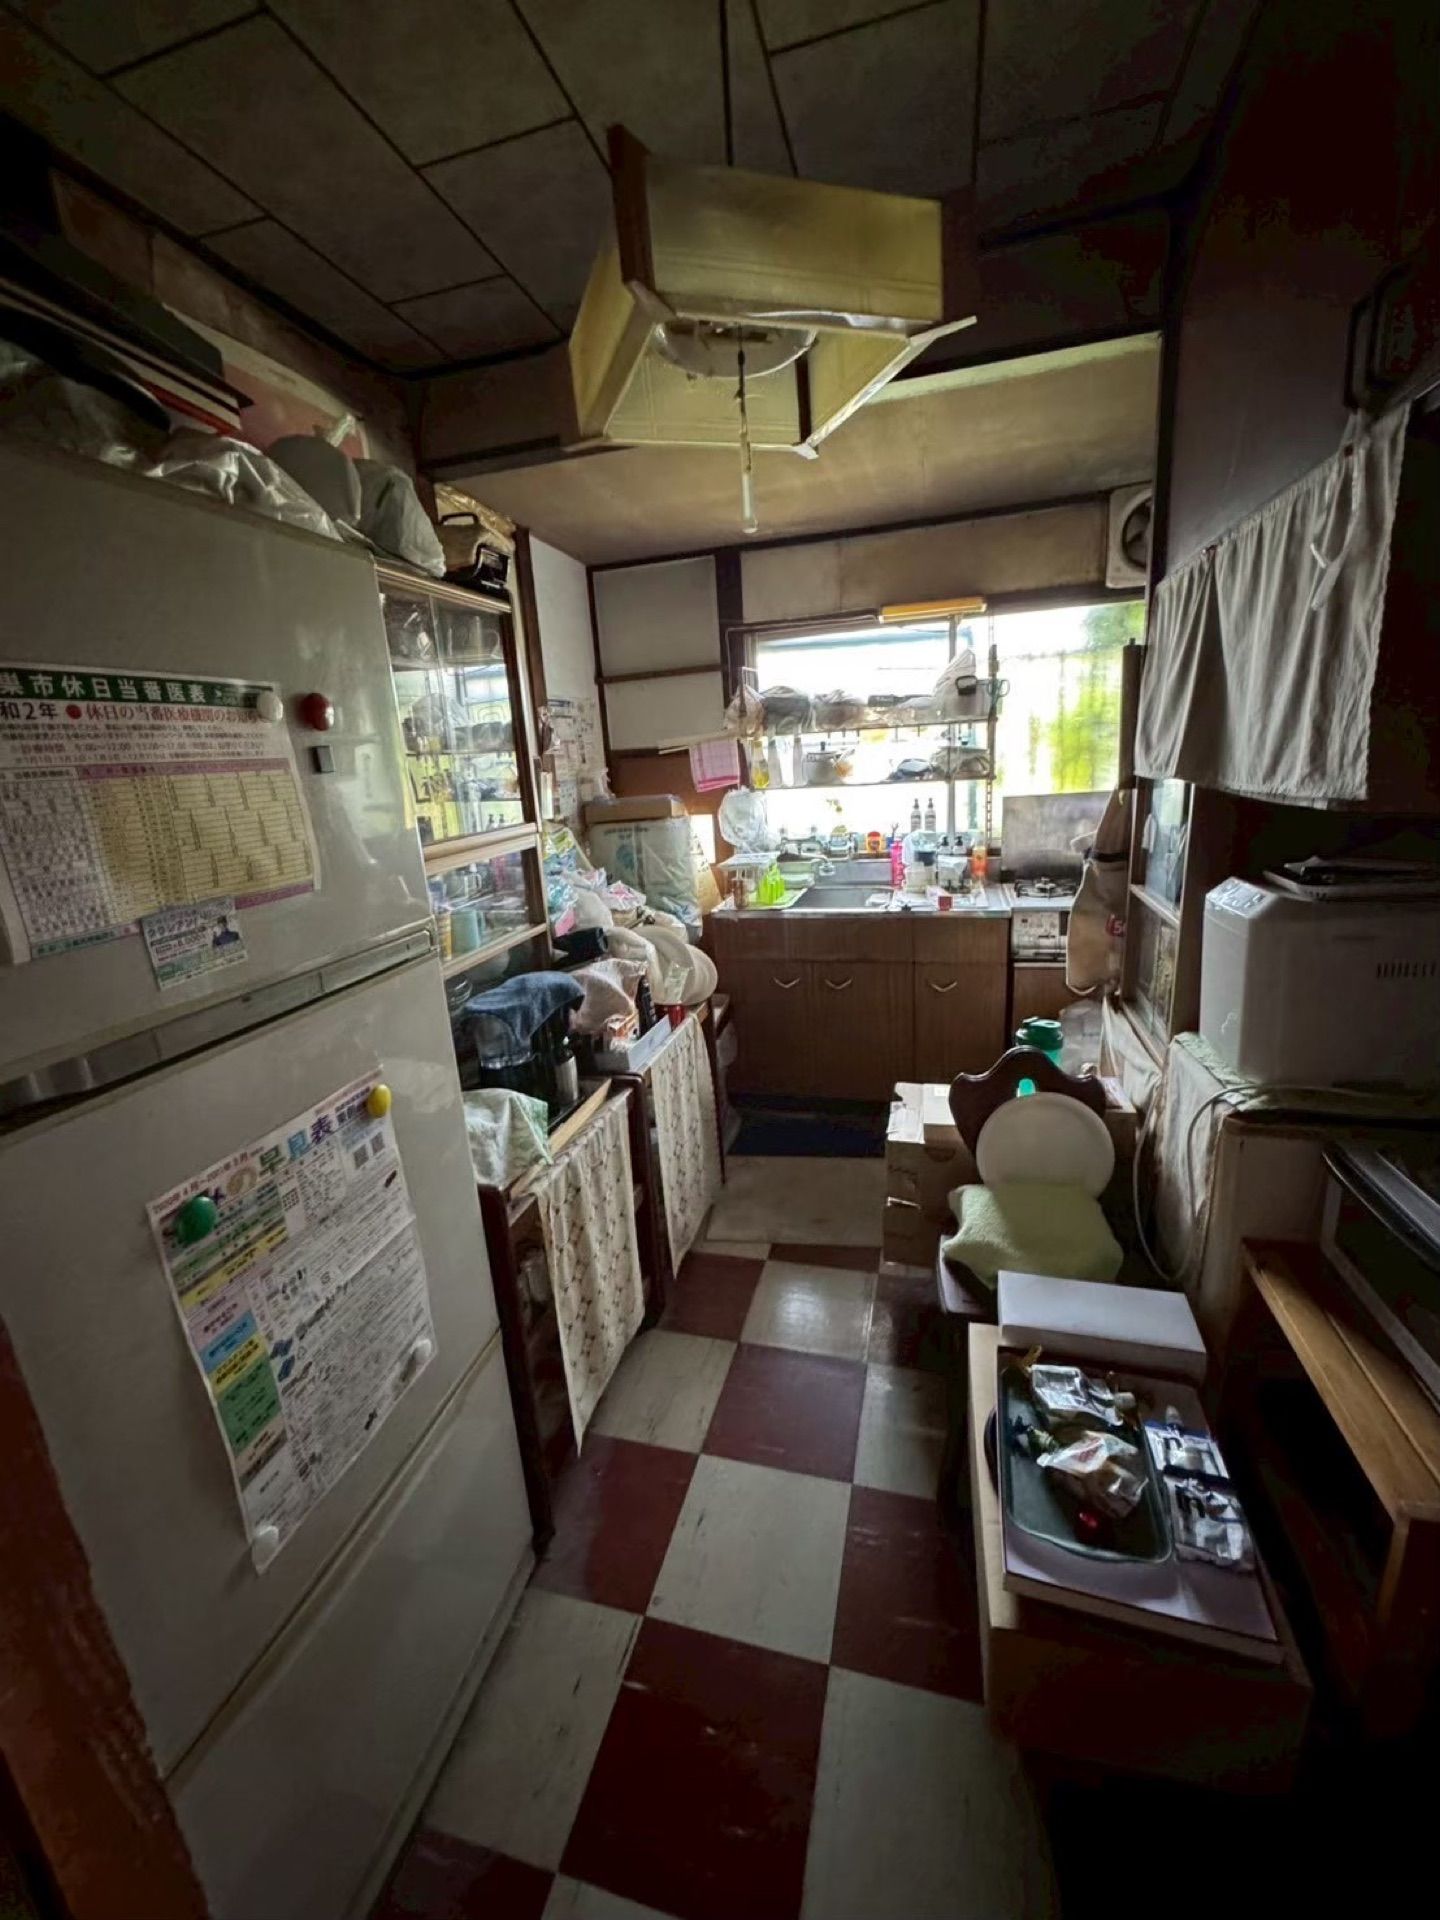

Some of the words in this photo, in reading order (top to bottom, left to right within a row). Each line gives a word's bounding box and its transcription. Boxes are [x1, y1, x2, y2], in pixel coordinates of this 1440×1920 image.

[86, 703, 259, 722] 休日の当番医療機関のお知ら
